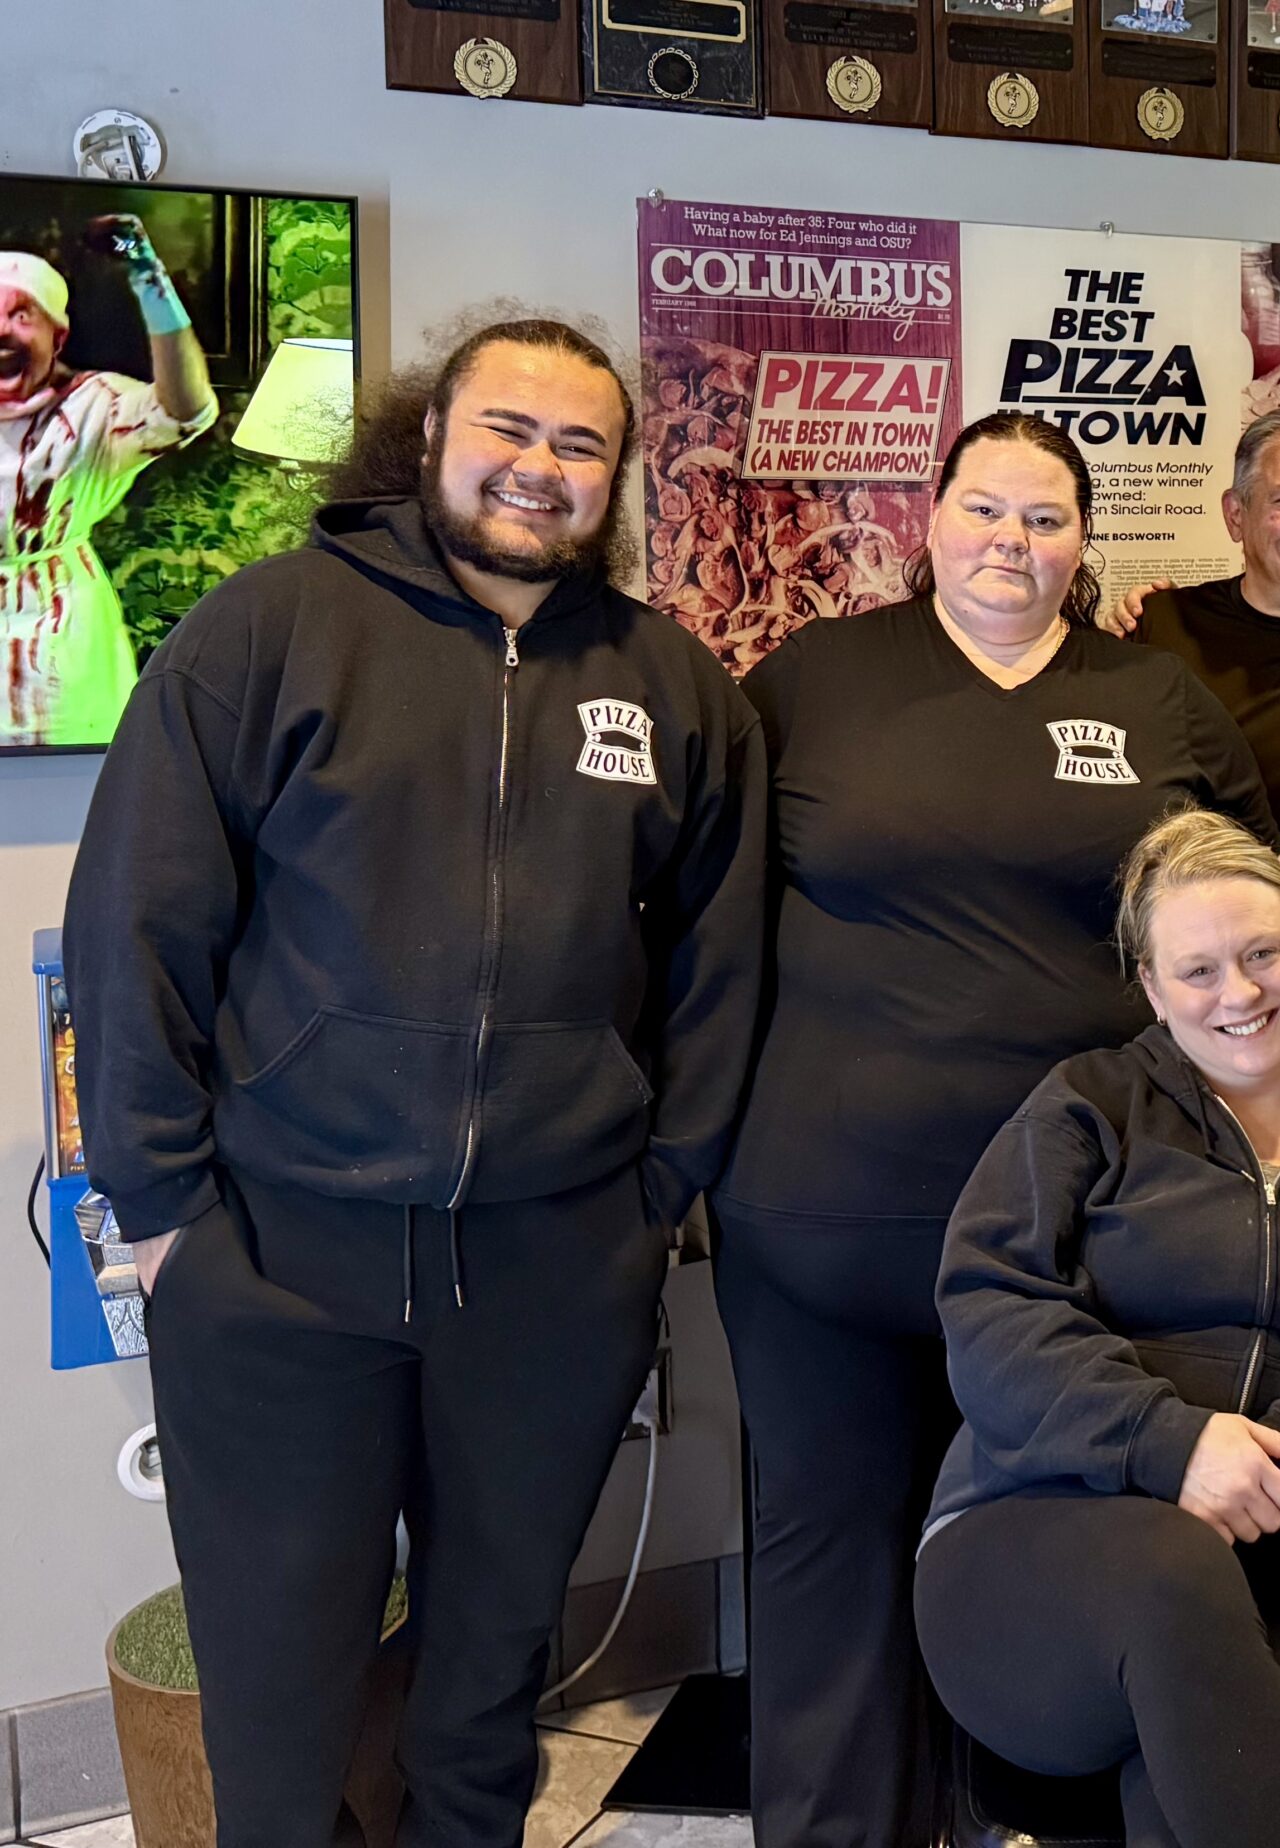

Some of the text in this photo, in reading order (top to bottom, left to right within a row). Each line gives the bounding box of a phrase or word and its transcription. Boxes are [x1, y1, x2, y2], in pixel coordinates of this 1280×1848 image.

[684, 207, 917, 235] Having a baby after 35: Four who did it
[693, 223, 912, 249] What now for Ed Jennings and OSU?
[650, 248, 952, 307] COLUMBUS
[1064, 268, 1144, 304] THE
[811, 289, 916, 342] Monthly
[1049, 307, 1155, 343] BEST
[761, 358, 944, 414] PIZZA!
[999, 338, 1207, 407] PIZZA
[757, 419, 934, 447] THE BEST IN TOWN
[1053, 410, 1207, 446] TOWN
[750, 446, 930, 477] (A NEW CHAMPION)
[1085, 461, 1213, 476] olumbus Monthly
[1109, 478, 1119, 487] a
[1123, 478, 1154, 487] new
[1157, 476, 1204, 488] winner
[1110, 503, 1161, 515] Sinclair
[1165, 505, 1206, 515] Road.
[1112, 533, 1175, 541] BOSWORTH
[588, 705, 648, 737] PIZZA
[1057, 725, 1117, 746] PIZZA
[586, 748, 649, 777] HOUSE
[1064, 759, 1130, 779] HOUSE
